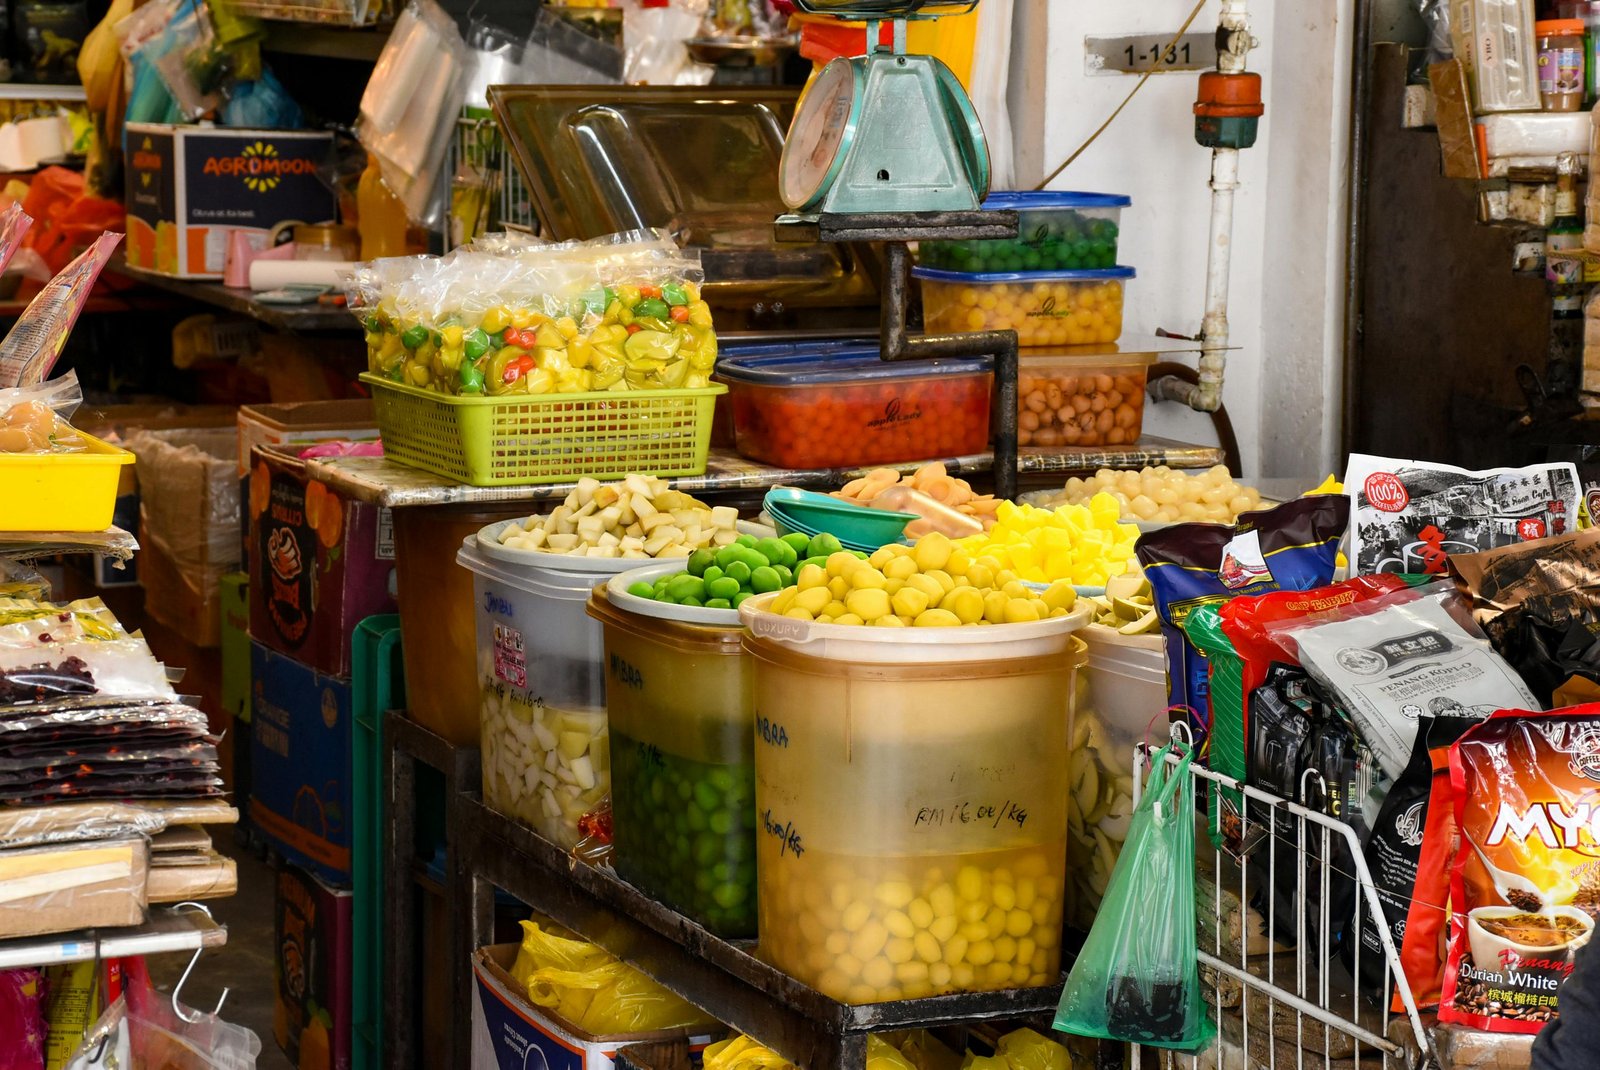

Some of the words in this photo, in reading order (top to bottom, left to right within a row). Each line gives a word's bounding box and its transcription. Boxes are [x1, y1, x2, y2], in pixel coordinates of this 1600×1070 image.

[1125, 42, 1190, 66] 1-131
[1370, 483, 1402, 501] 100%
[757, 622, 800, 637] LUXURY
[1380, 674, 1428, 692] PENANG
[1462, 963, 1503, 983] Durian
[1508, 971, 1558, 990] White
